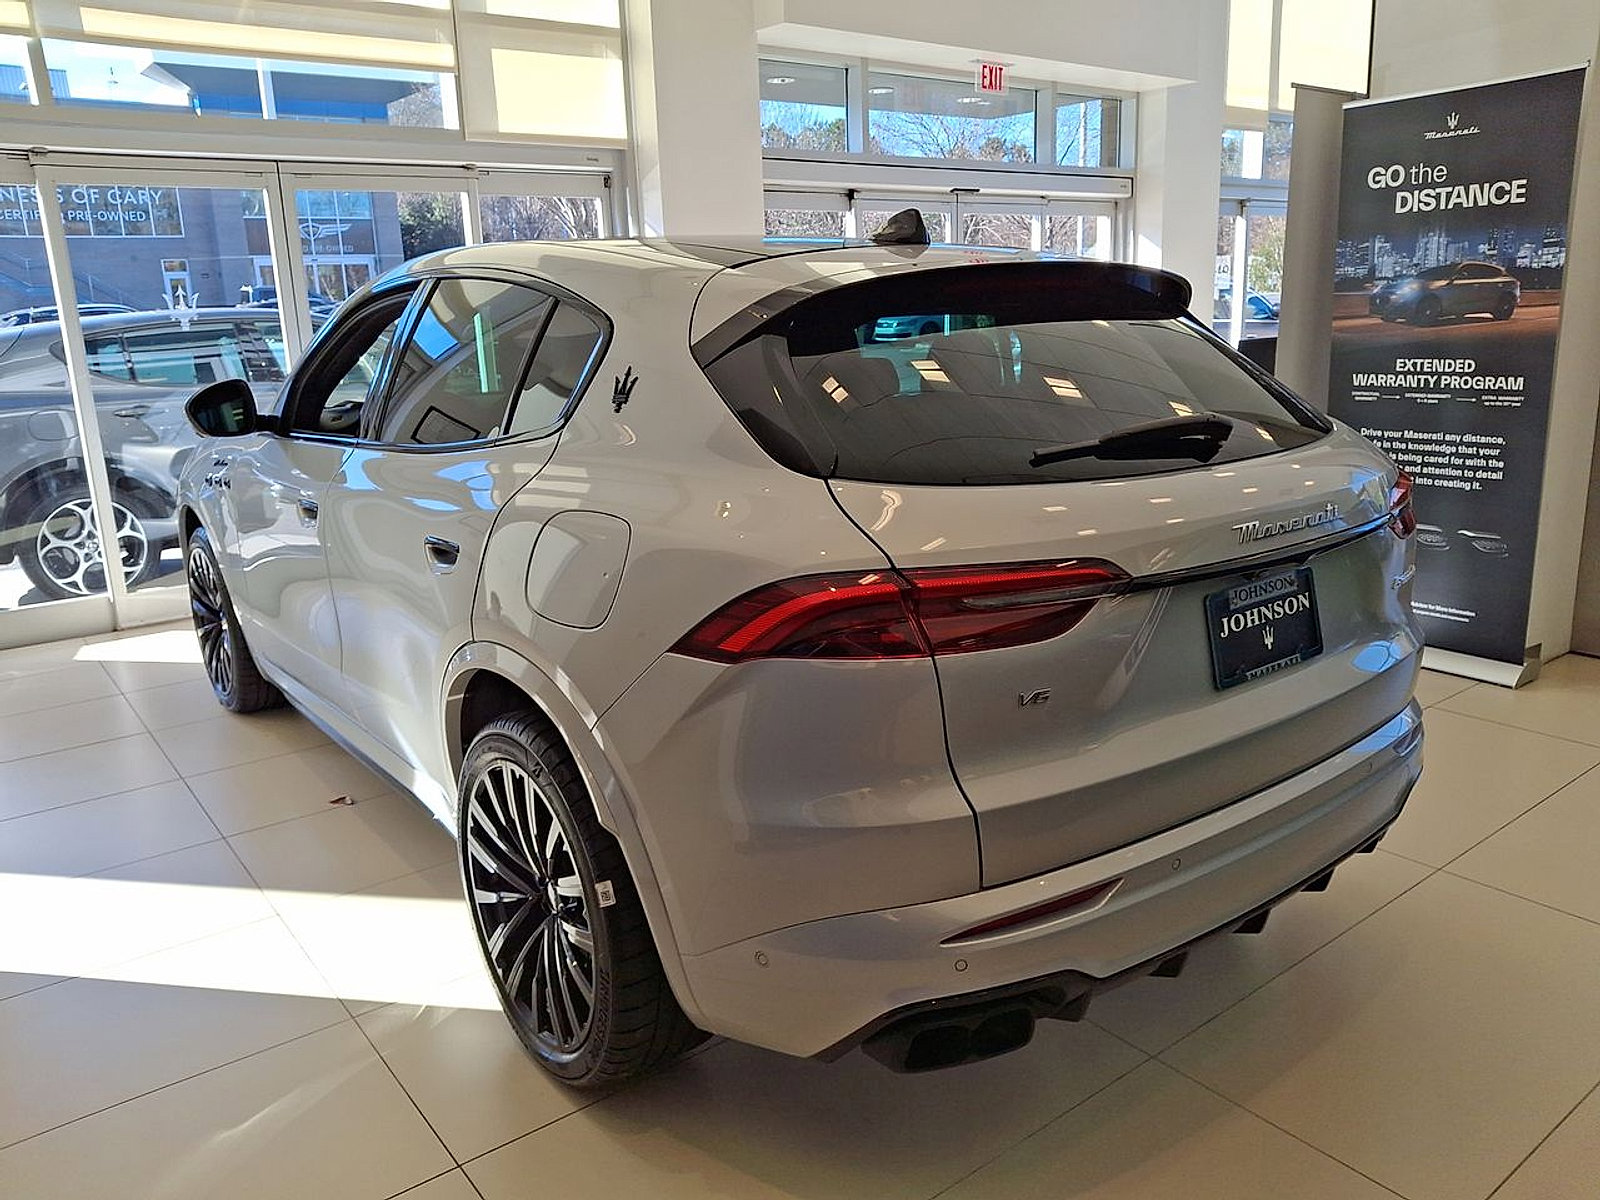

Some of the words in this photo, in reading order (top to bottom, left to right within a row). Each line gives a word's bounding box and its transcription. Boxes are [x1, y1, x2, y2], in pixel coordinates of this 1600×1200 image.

[981, 63, 1004, 91] EXIT
[1424, 126, 1481, 139] Maserati
[1367, 164, 1405, 189] GO
[1410, 163, 1448, 185] the
[72, 188, 100, 204] OF
[107, 190, 162, 205] CARY
[1395, 179, 1528, 214] DISTANCE
[67, 210, 146, 221] PRE-OWNED
[1396, 358, 1476, 372] EXTENDED
[1352, 374, 1438, 389] WARRANTY
[1440, 375, 1524, 390] PROGRAM
[1361, 428, 1382, 437] Drive
[1384, 430, 1402, 438] your
[1404, 430, 1443, 440] Maserati
[1445, 433, 1461, 443] any
[1463, 434, 1506, 445] distance,
[1383, 440, 1391, 448] in
[1393, 441, 1406, 449] the
[1408, 442, 1456, 454] knowledge
[1458, 445, 1477, 454] that
[1479, 447, 1500, 456] your
[1398, 453, 1422, 463] being
[1424, 455, 1449, 464] cared
[1451, 456, 1464, 465] for
[1465, 458, 1486, 467] with
[1488, 459, 1504, 468] the
[1404, 465, 1421, 473] and
[1422, 466, 1462, 476] attention
[1464, 469, 1474, 477] to
[1475, 470, 1503, 480] detail
[1415, 476, 1433, 485] into
[1434, 478, 1471, 490] creating
[1472, 481, 1482, 490] it.
[1231, 503, 1344, 543] Maserati
[1231, 576, 1296, 605] JOHNSON
[1220, 592, 1310, 638] JOHNSON
[1018, 687, 1051, 707] V6
